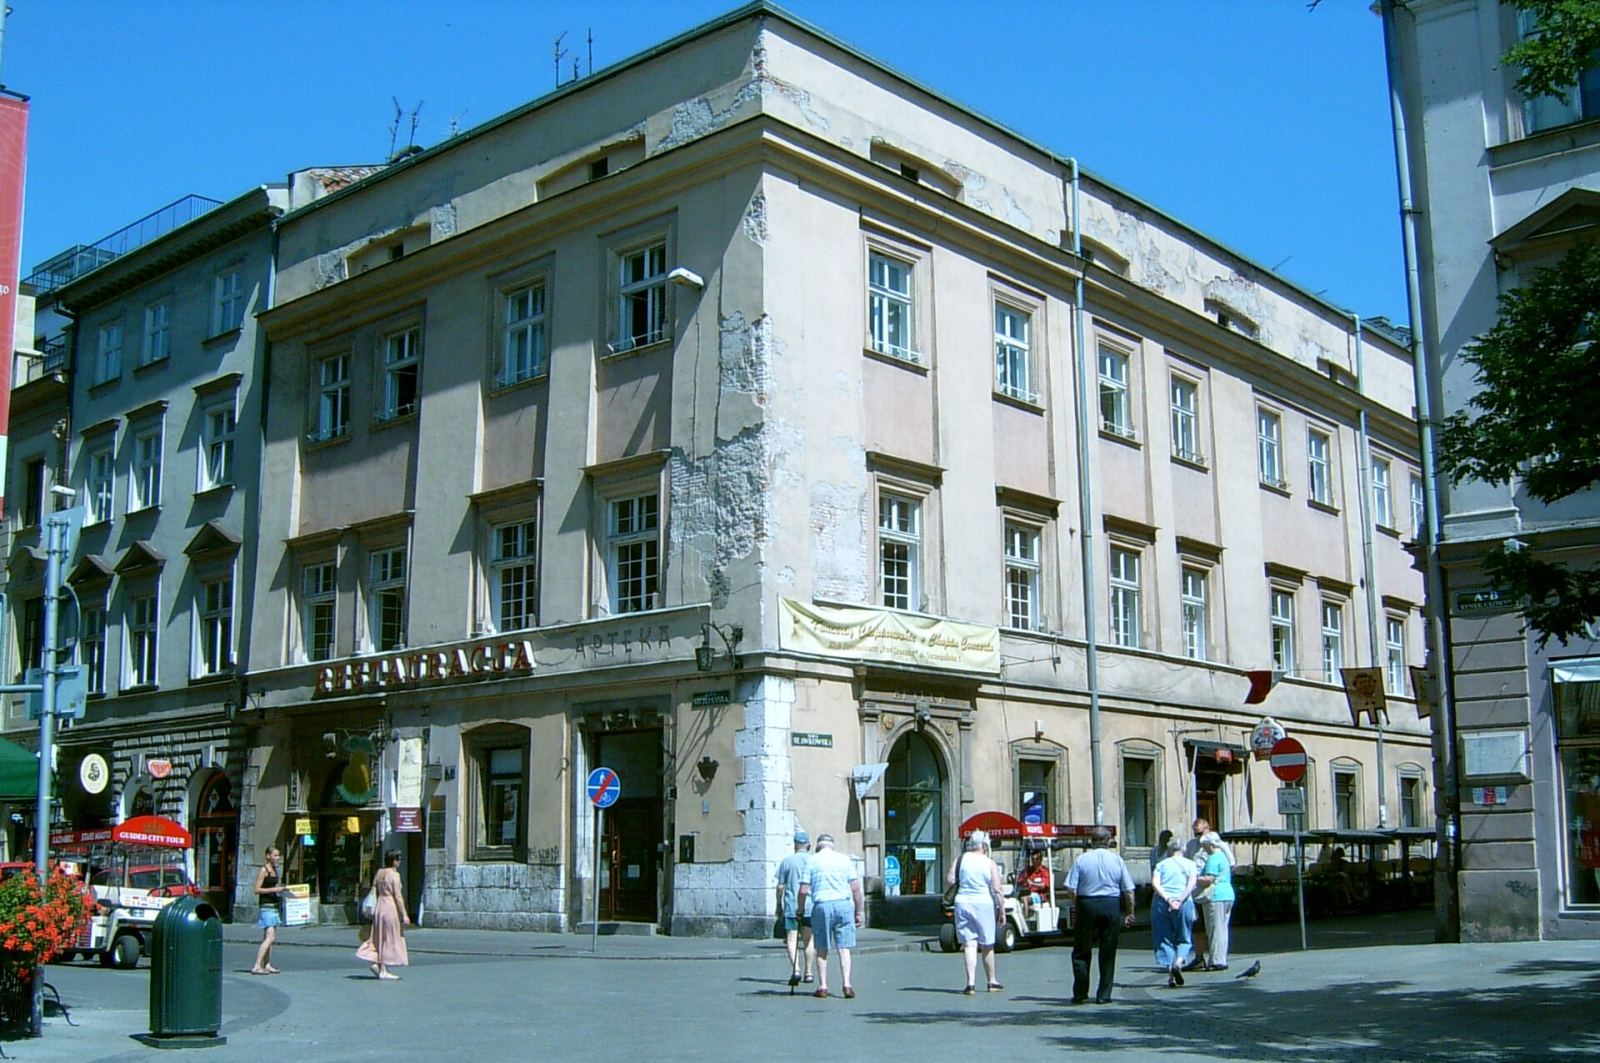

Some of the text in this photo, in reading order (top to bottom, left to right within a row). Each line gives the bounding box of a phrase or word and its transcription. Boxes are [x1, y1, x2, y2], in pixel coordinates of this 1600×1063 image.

[575, 625, 672, 660] APTEKA
[317, 641, 536, 693] RESTAURACJA
[119, 831, 185, 844] GUIDED CITY TOUR
